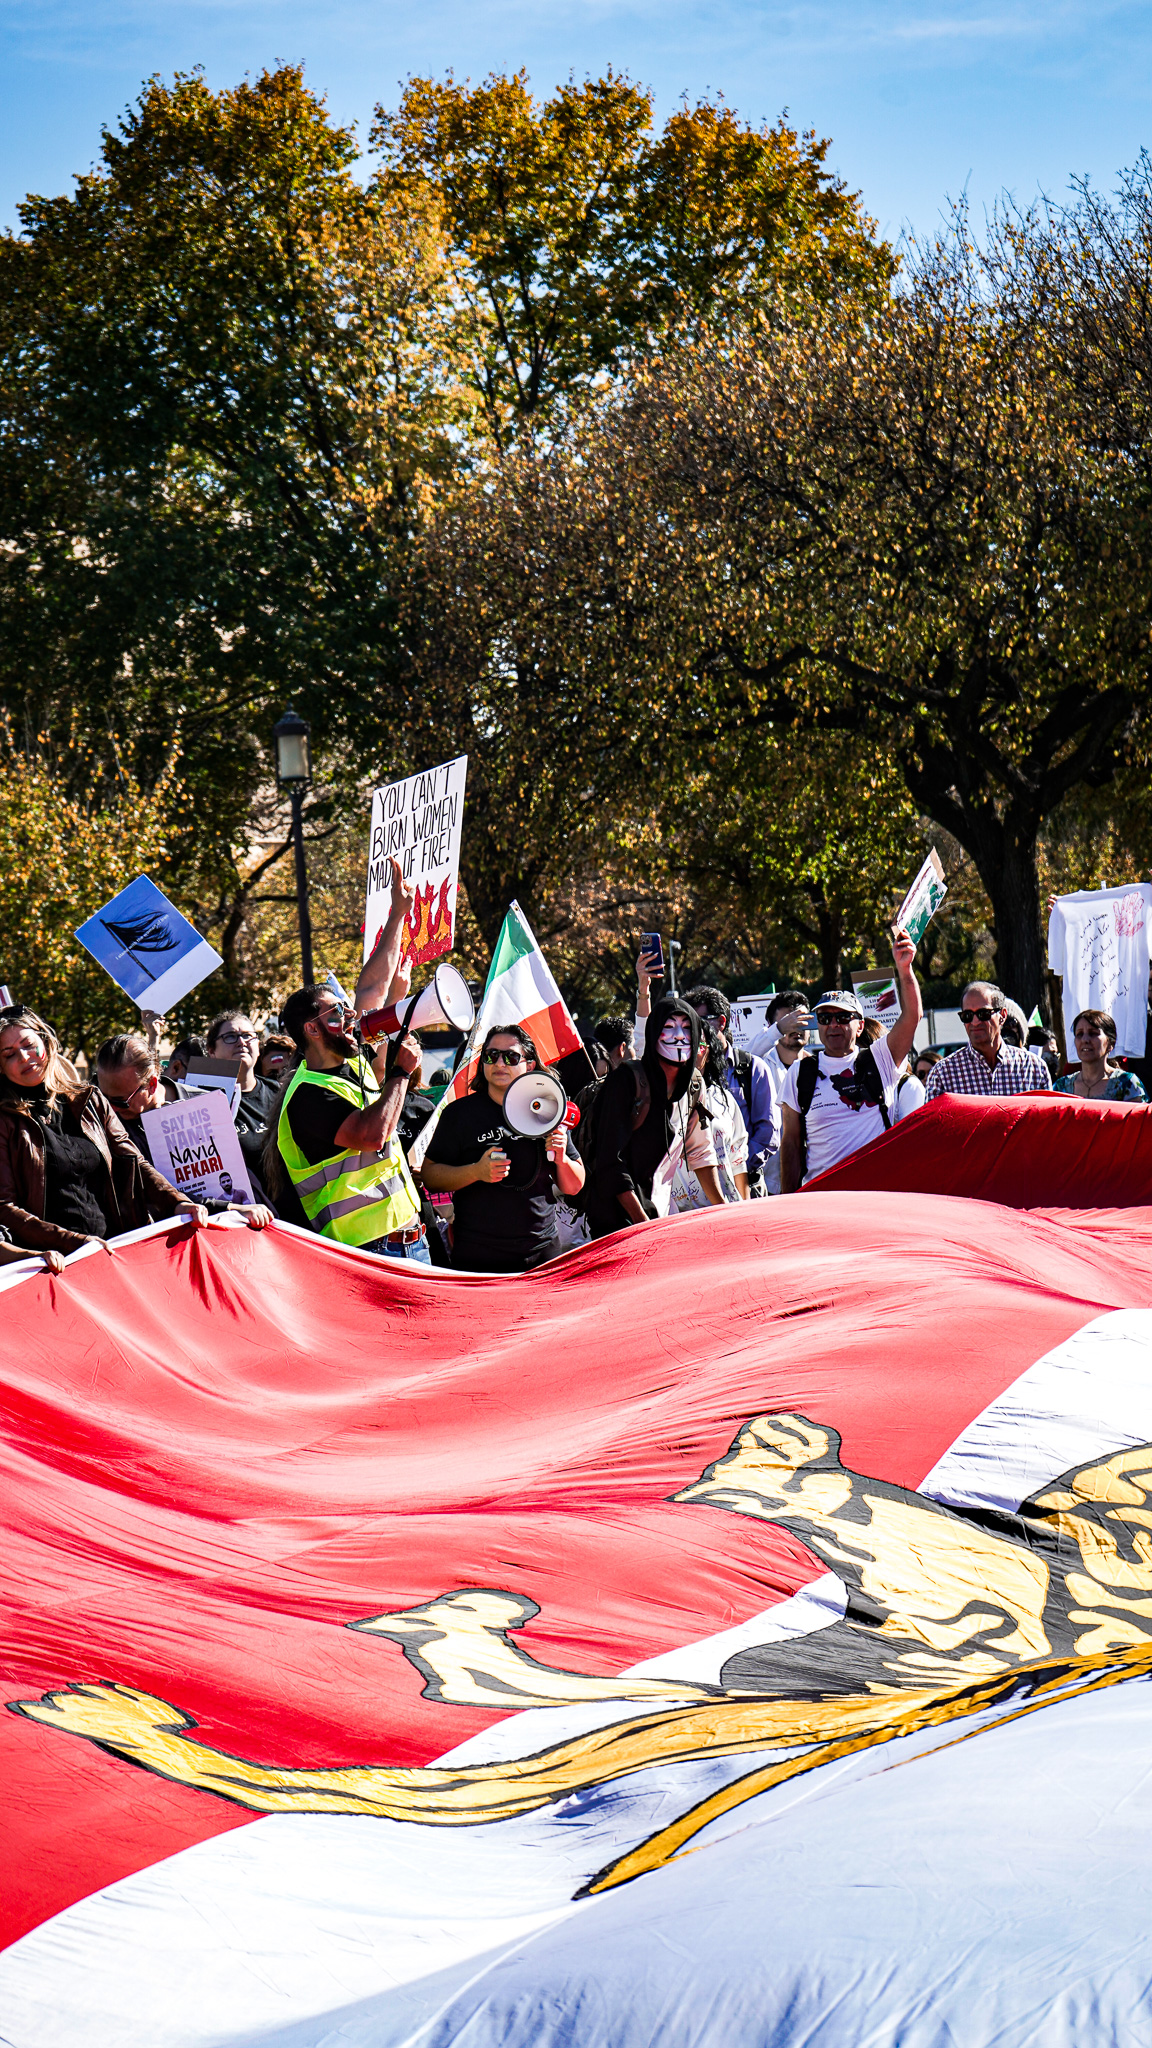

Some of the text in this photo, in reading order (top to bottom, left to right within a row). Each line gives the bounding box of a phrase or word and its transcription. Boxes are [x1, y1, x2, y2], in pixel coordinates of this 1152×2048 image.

[379, 763, 456, 822] YOU CAN'T
[373, 792, 458, 860] BURN WOMEN
[403, 845, 418, 879] OF
[421, 829, 452, 872] FIRE!
[160, 1107, 211, 1134] SAY HIS
[164, 1122, 216, 1152] NAME
[169, 1136, 220, 1168] Navid
[174, 1155, 224, 1184] AFKARI
